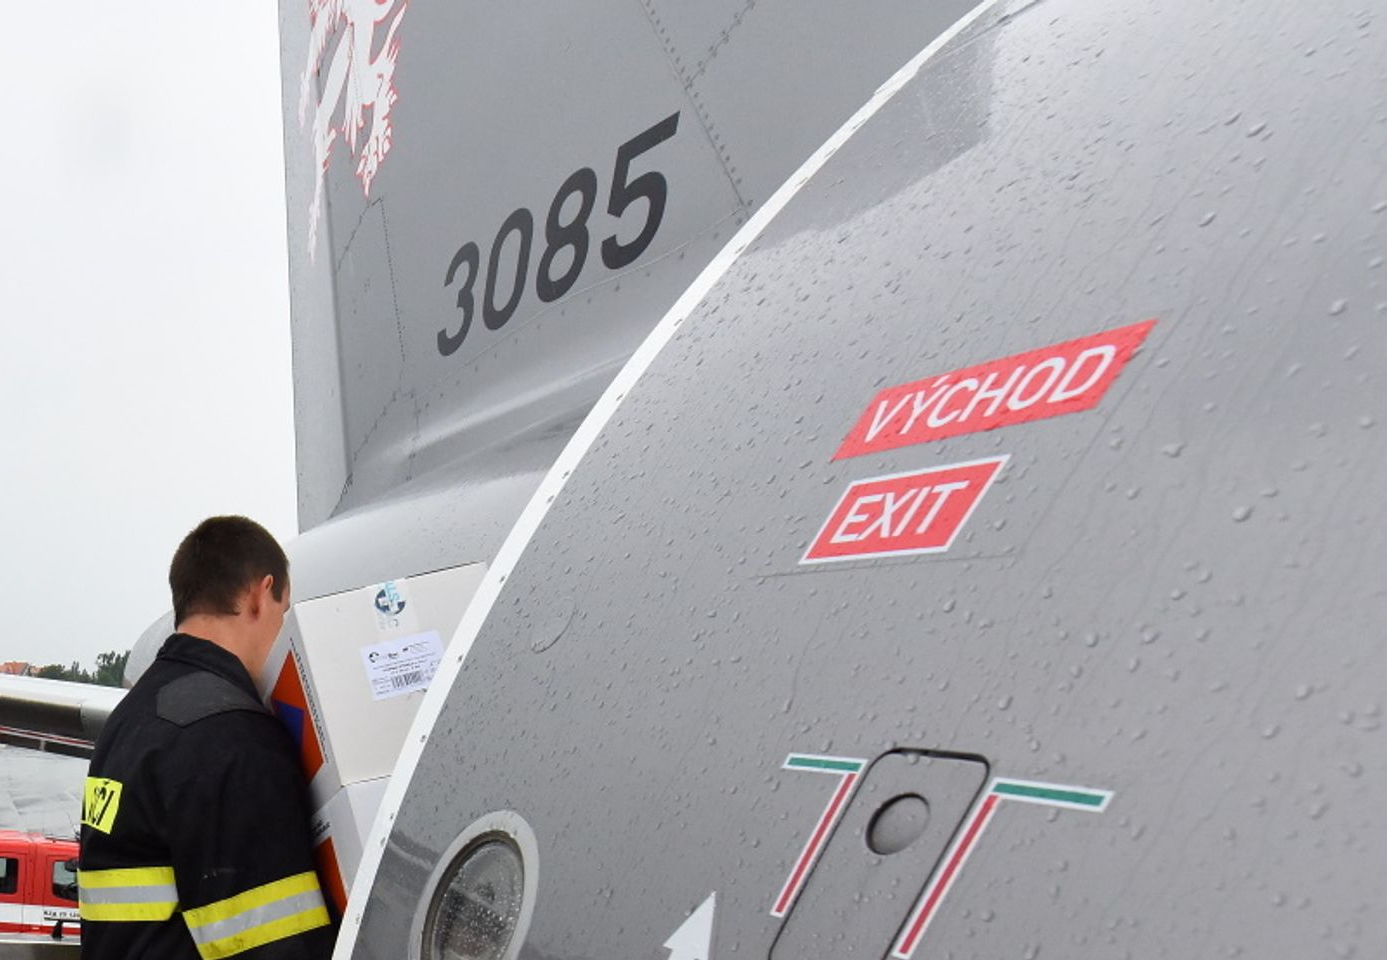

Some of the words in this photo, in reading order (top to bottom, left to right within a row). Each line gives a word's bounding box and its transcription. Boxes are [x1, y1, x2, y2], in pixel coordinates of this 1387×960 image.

[436, 110, 681, 357] 3085
[864, 344, 1116, 443] VÝCHOD
[829, 480, 970, 544] EXIT
